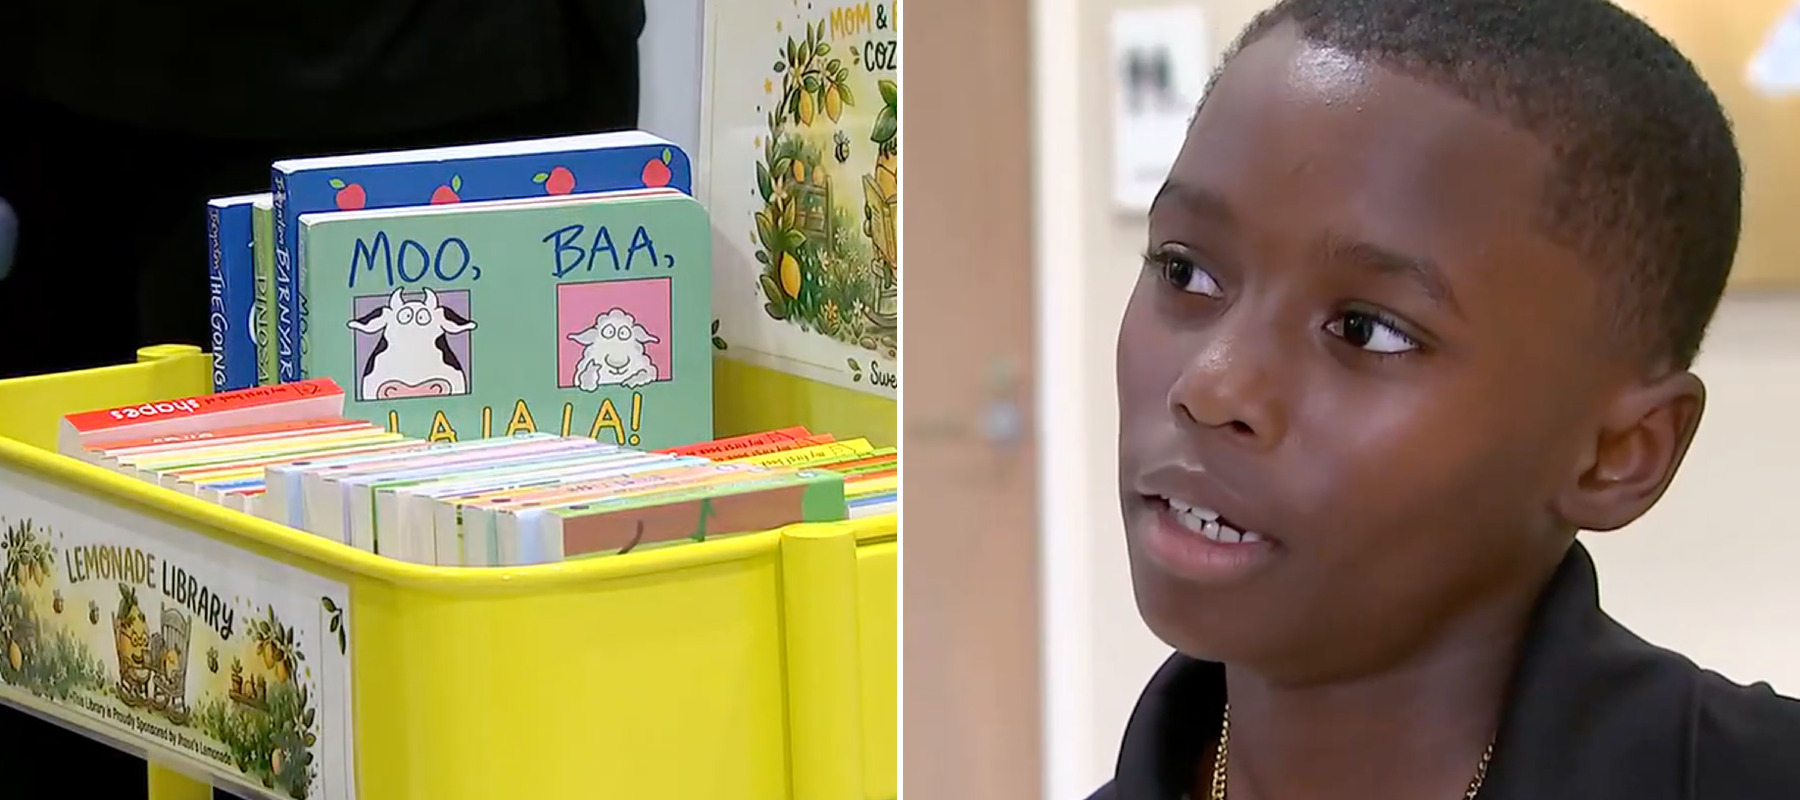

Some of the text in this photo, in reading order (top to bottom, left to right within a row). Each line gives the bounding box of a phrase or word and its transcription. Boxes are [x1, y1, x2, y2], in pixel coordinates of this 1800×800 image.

[829, 2, 871, 41] MOM
[876, 3, 888, 30] &
[348, 230, 481, 288] MOO,
[543, 224, 675, 278] BAA,
[210, 269, 227, 314] THE
[275, 246, 294, 384] BARNYAR
[211, 311, 229, 387] GOING
[255, 274, 269, 384] DINOSA
[110, 399, 200, 420] shapes
[65, 545, 234, 641] LEMONADE LIBRARY
